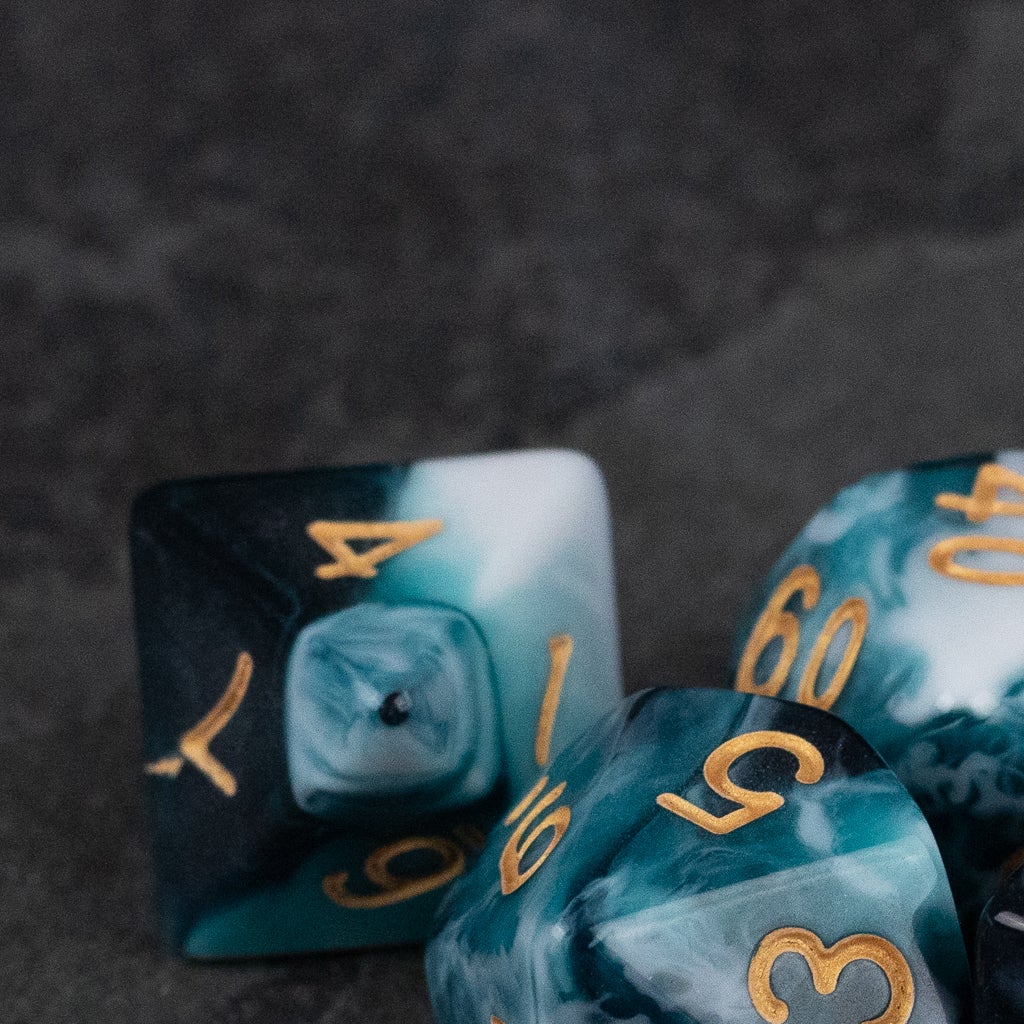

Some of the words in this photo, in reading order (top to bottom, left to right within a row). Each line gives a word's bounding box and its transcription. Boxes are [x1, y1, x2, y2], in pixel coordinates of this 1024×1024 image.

[306, 519, 443, 581] 4
[734, 564, 869, 712] 60
[656, 728, 826, 835] 5
